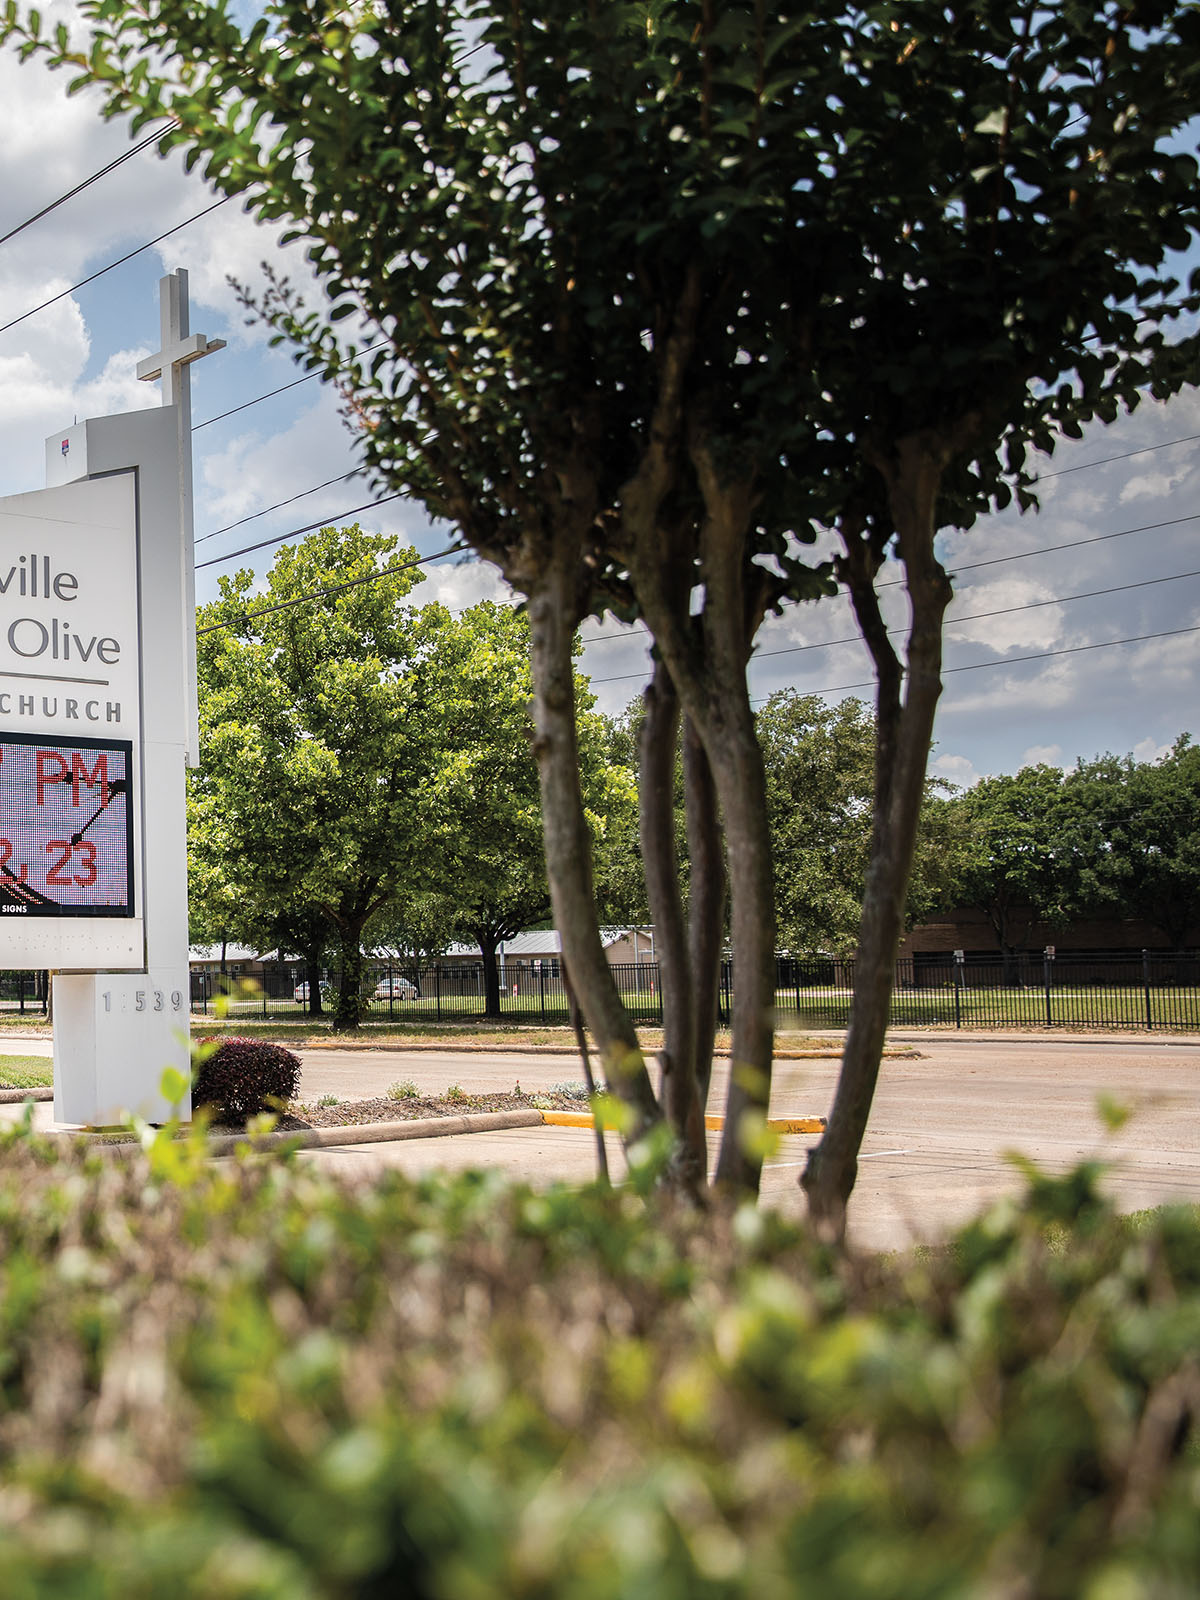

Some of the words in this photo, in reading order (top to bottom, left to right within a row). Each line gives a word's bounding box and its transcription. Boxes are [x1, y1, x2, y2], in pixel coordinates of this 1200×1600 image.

[7, 618, 121, 664] Olive
[36, 750, 109, 808] PM
[45, 839, 98, 887] 23
[1, 905, 27, 913] SIGNS
